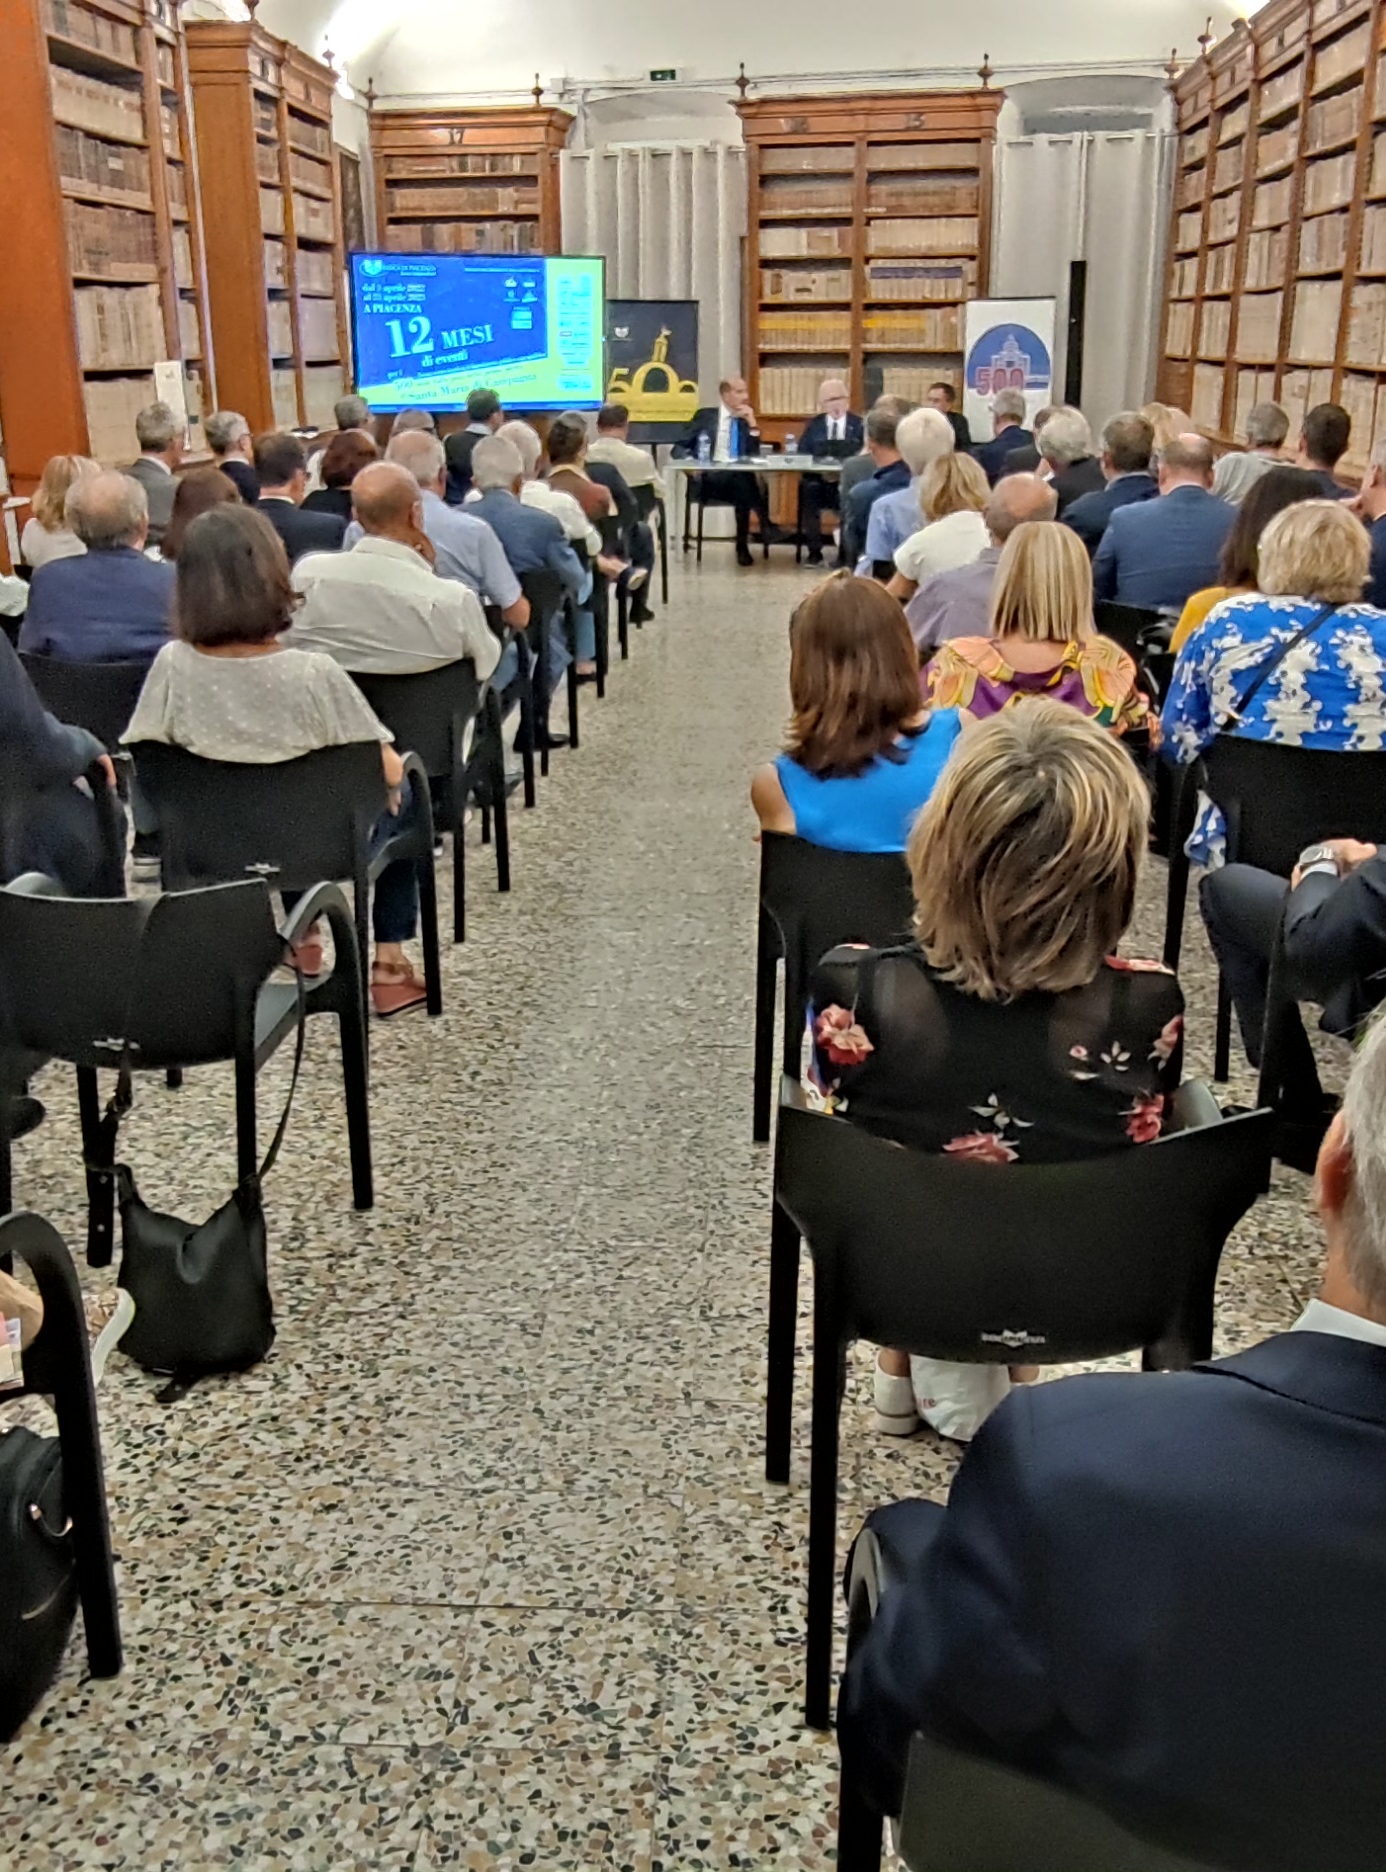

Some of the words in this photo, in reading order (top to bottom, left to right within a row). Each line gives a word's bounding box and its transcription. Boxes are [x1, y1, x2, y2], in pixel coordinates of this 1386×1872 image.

[364, 303, 371, 313] A
[373, 303, 422, 313] PIACENZA
[385, 316, 434, 358] 12
[441, 324, 494, 349] MESI
[422, 354, 433, 367] di
[435, 349, 469, 365] eventi
[975, 366, 1024, 396] 500
